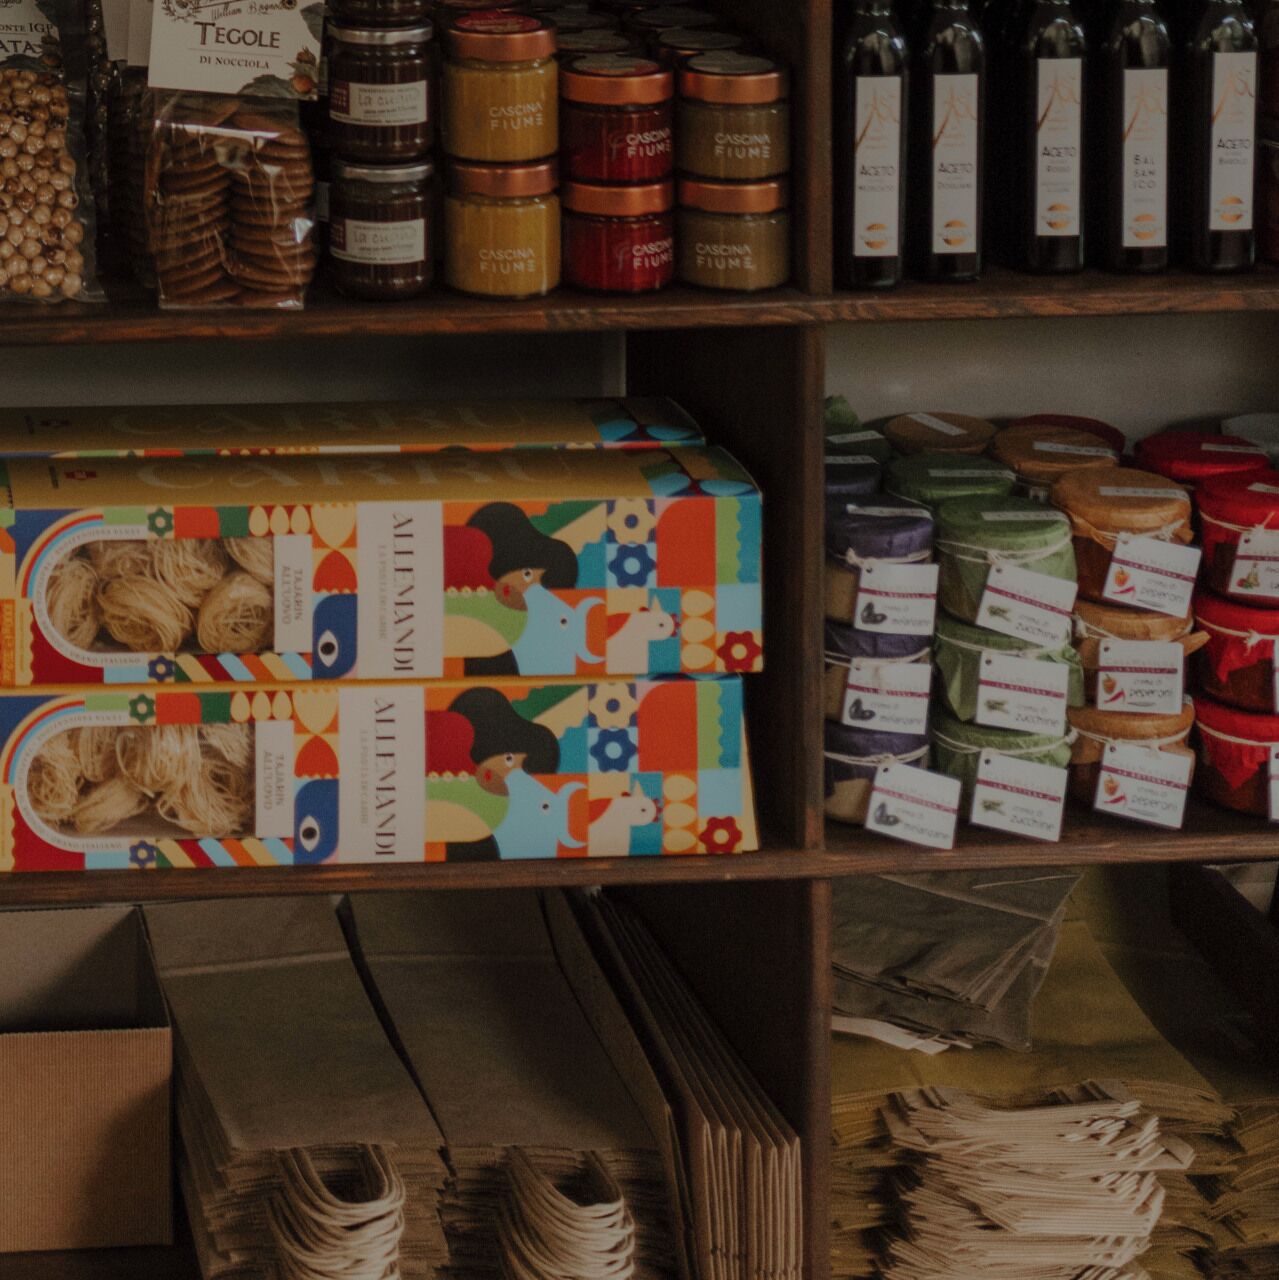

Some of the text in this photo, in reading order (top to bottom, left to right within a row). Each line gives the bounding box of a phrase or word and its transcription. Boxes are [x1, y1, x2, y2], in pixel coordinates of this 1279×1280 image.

[25, 21, 54, 33] IGP
[192, 21, 281, 49] TEGOLE
[199, 57, 270, 70] DI NOCCIOLA
[488, 102, 543, 117] CASCINA
[489, 114, 544, 131] FIUME
[392, 512, 415, 672] ALLEMANDI
[373, 696, 397, 856] ALLEMANDI
